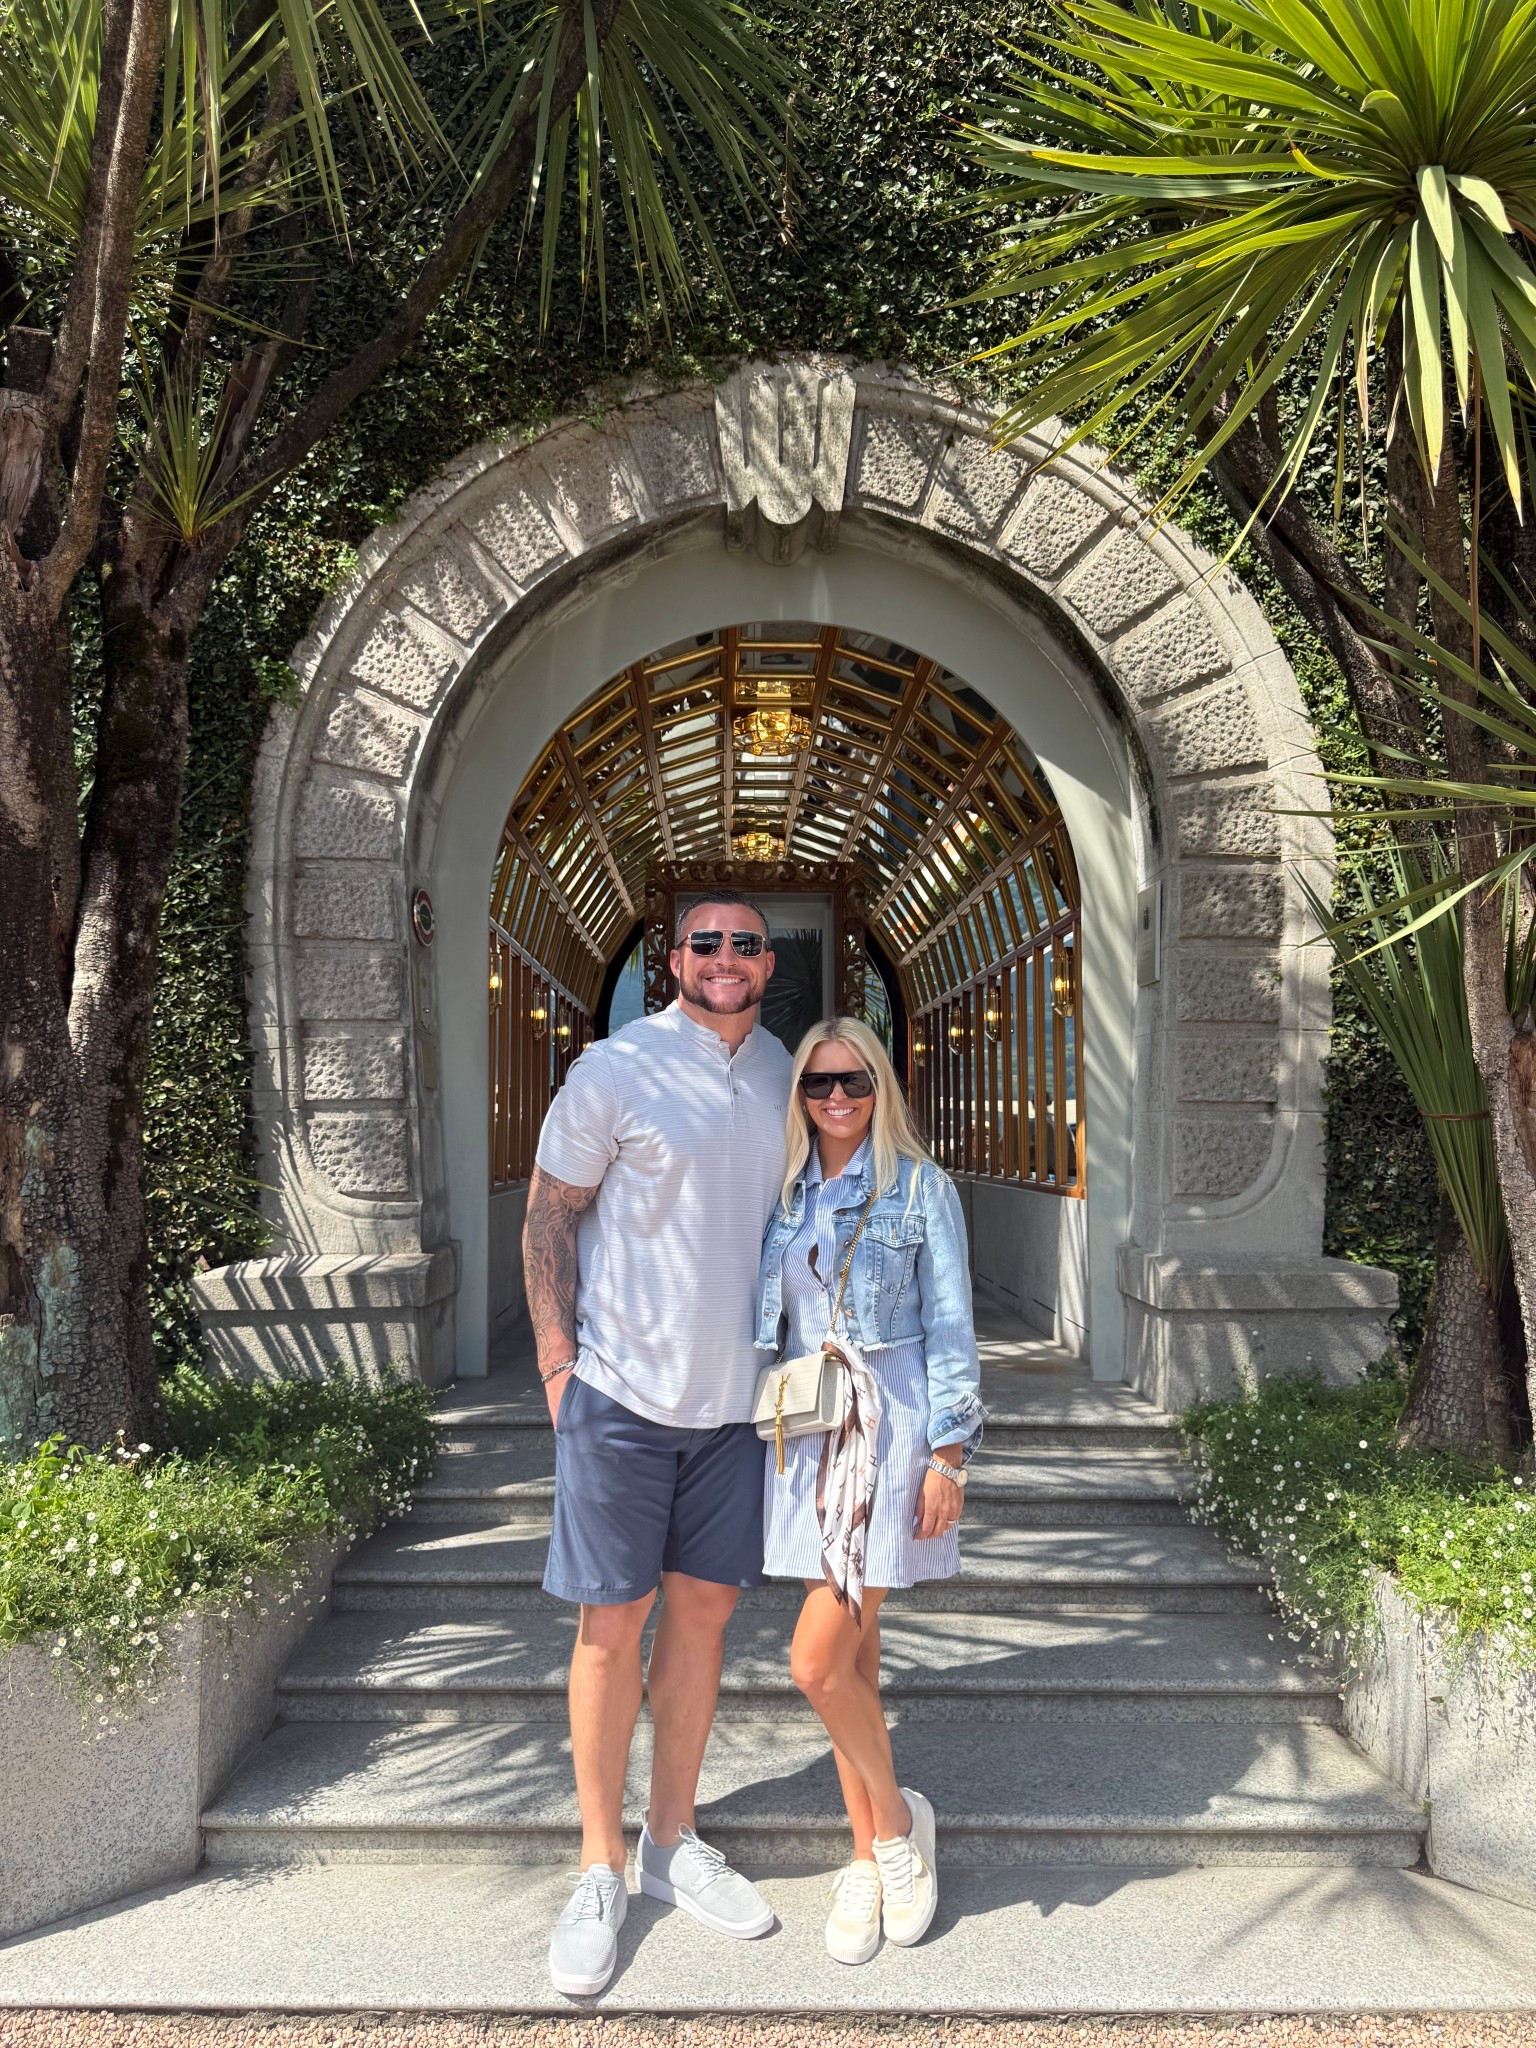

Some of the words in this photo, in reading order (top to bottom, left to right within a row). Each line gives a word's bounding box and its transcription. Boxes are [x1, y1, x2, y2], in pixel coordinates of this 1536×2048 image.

[863, 1414, 876, 1430] H
[868, 1454, 878, 1467] H
[822, 1532, 835, 1551] H
